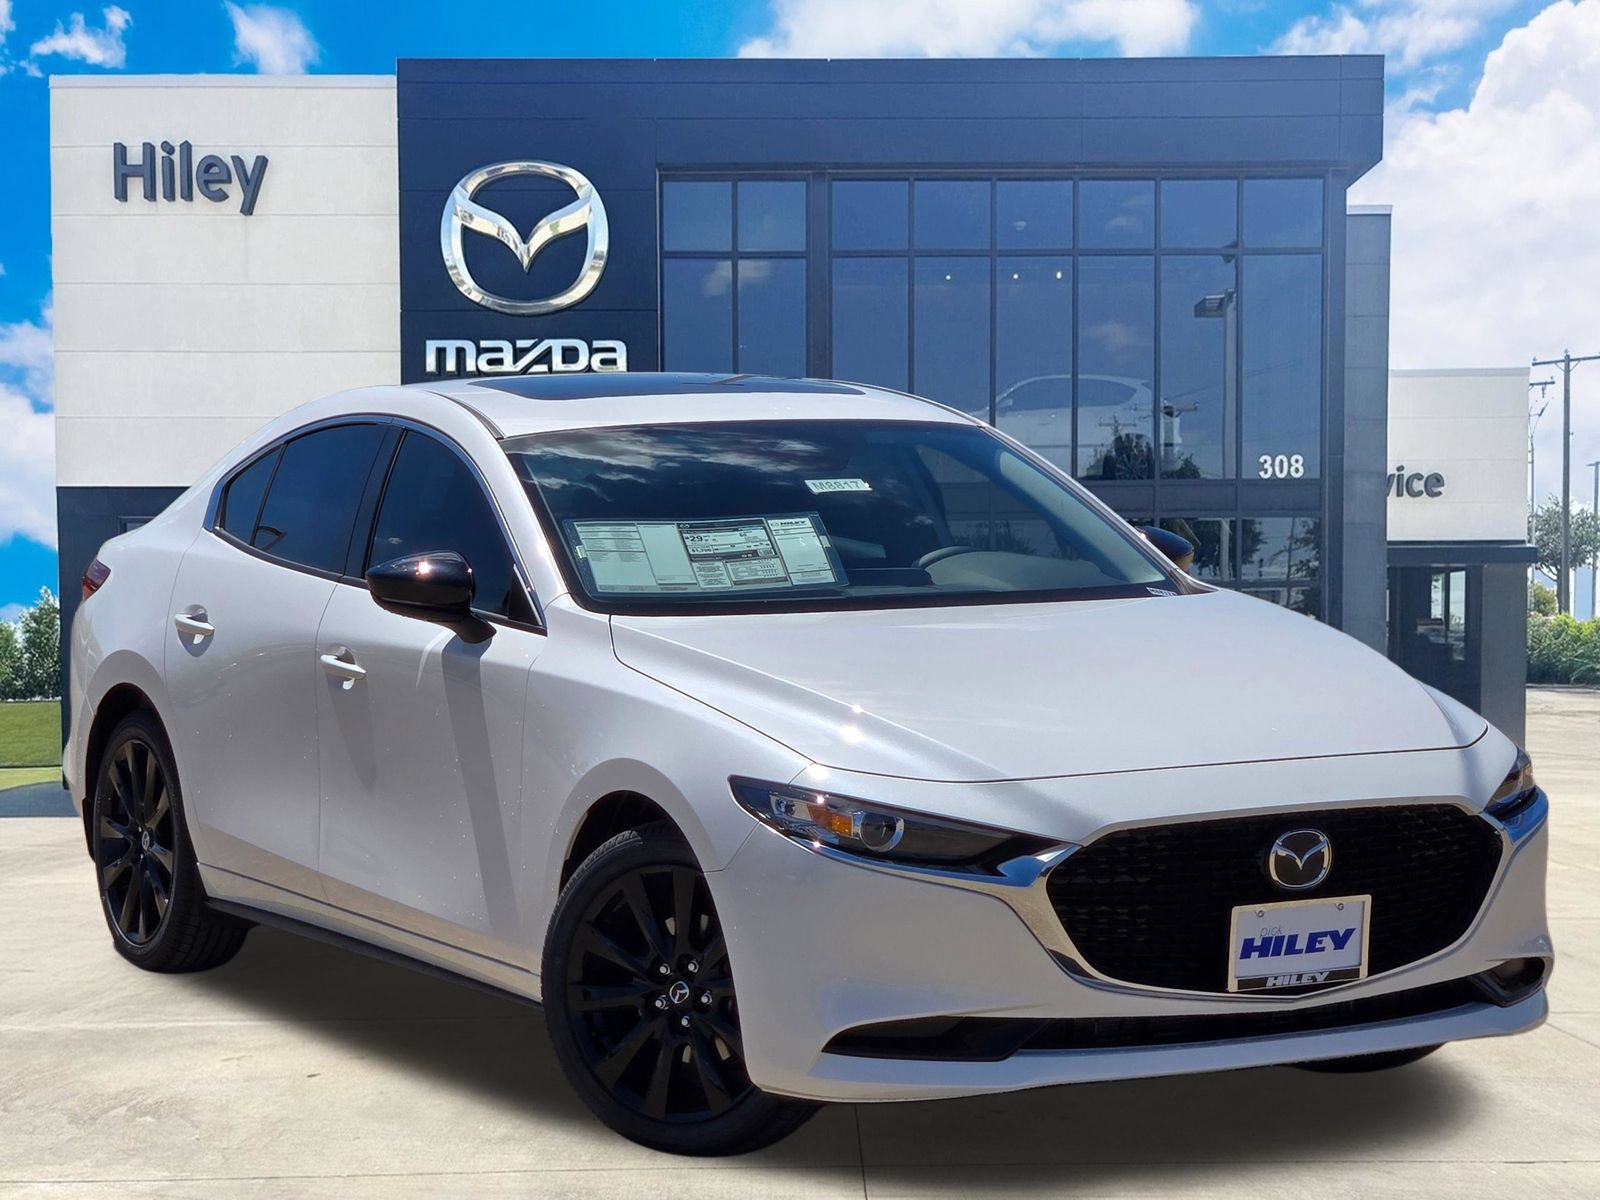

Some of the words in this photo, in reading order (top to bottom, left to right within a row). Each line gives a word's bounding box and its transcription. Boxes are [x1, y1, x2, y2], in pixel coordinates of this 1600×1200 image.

[113, 140, 269, 216] Hiley
[1258, 454, 1305, 479] 308
[1240, 927, 1356, 960] HILEY
[1266, 971, 1330, 988] HILEY
